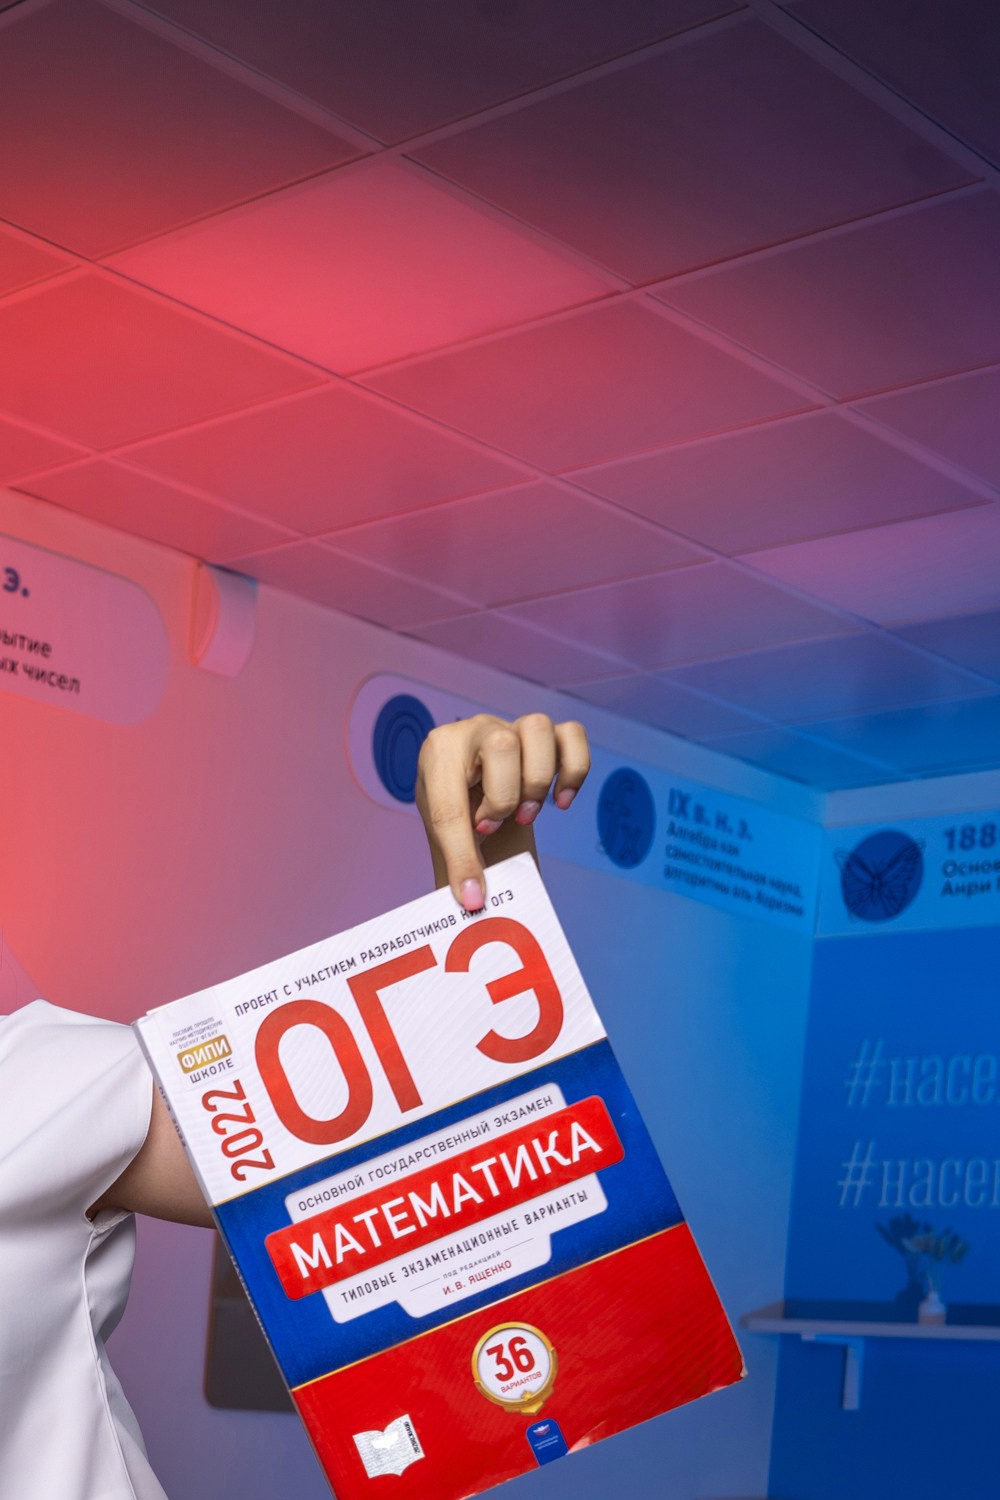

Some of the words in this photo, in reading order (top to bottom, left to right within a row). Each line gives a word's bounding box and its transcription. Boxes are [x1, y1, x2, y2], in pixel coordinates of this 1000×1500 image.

[2, 567, 29, 598] э.
[22, 663, 81, 694] чисел
[943, 822, 1000, 852] 188
[235, 989, 279, 1017] ПРОЕКТ
[283, 984, 292, 996] С
[294, 957, 357, 992] УЧАСТИЕМ
[360, 914, 457, 963] РАЗРАБОТЧИКОВ
[491, 889, 514, 907] ОГЭ
[254, 916, 564, 1147] ОГЭ
[182, 1039, 229, 1069] ФИПИ
[190, 1058, 234, 1084] ШКОЛЕ
[844, 1037, 1000, 1109] #насе
[201, 1079, 276, 1182] 2022
[298, 1175, 365, 1212] ОСНОВНОЙ
[368, 1120, 490, 1182] ГОСУДАРСТВЕННЫЙ
[494, 1096, 554, 1128] ЭКЗАМЕН
[289, 1121, 603, 1279] МАТЕМАТИКА
[341, 1274, 397, 1303] ТИПОВЫЕ
[402, 1219, 519, 1278] ЭКЗАМЕНАЦИОННЫЕ
[524, 1190, 588, 1225] ВАРИАНТЫ
[443, 1269, 458, 1279] ПОД
[459, 1250, 501, 1272] РЕДАКЦИЕЙ
[468, 1260, 512, 1285] ЯЩЕНКО
[486, 1336, 535, 1382] 36
[501, 1371, 542, 1393] ВАРИАНТОВ
